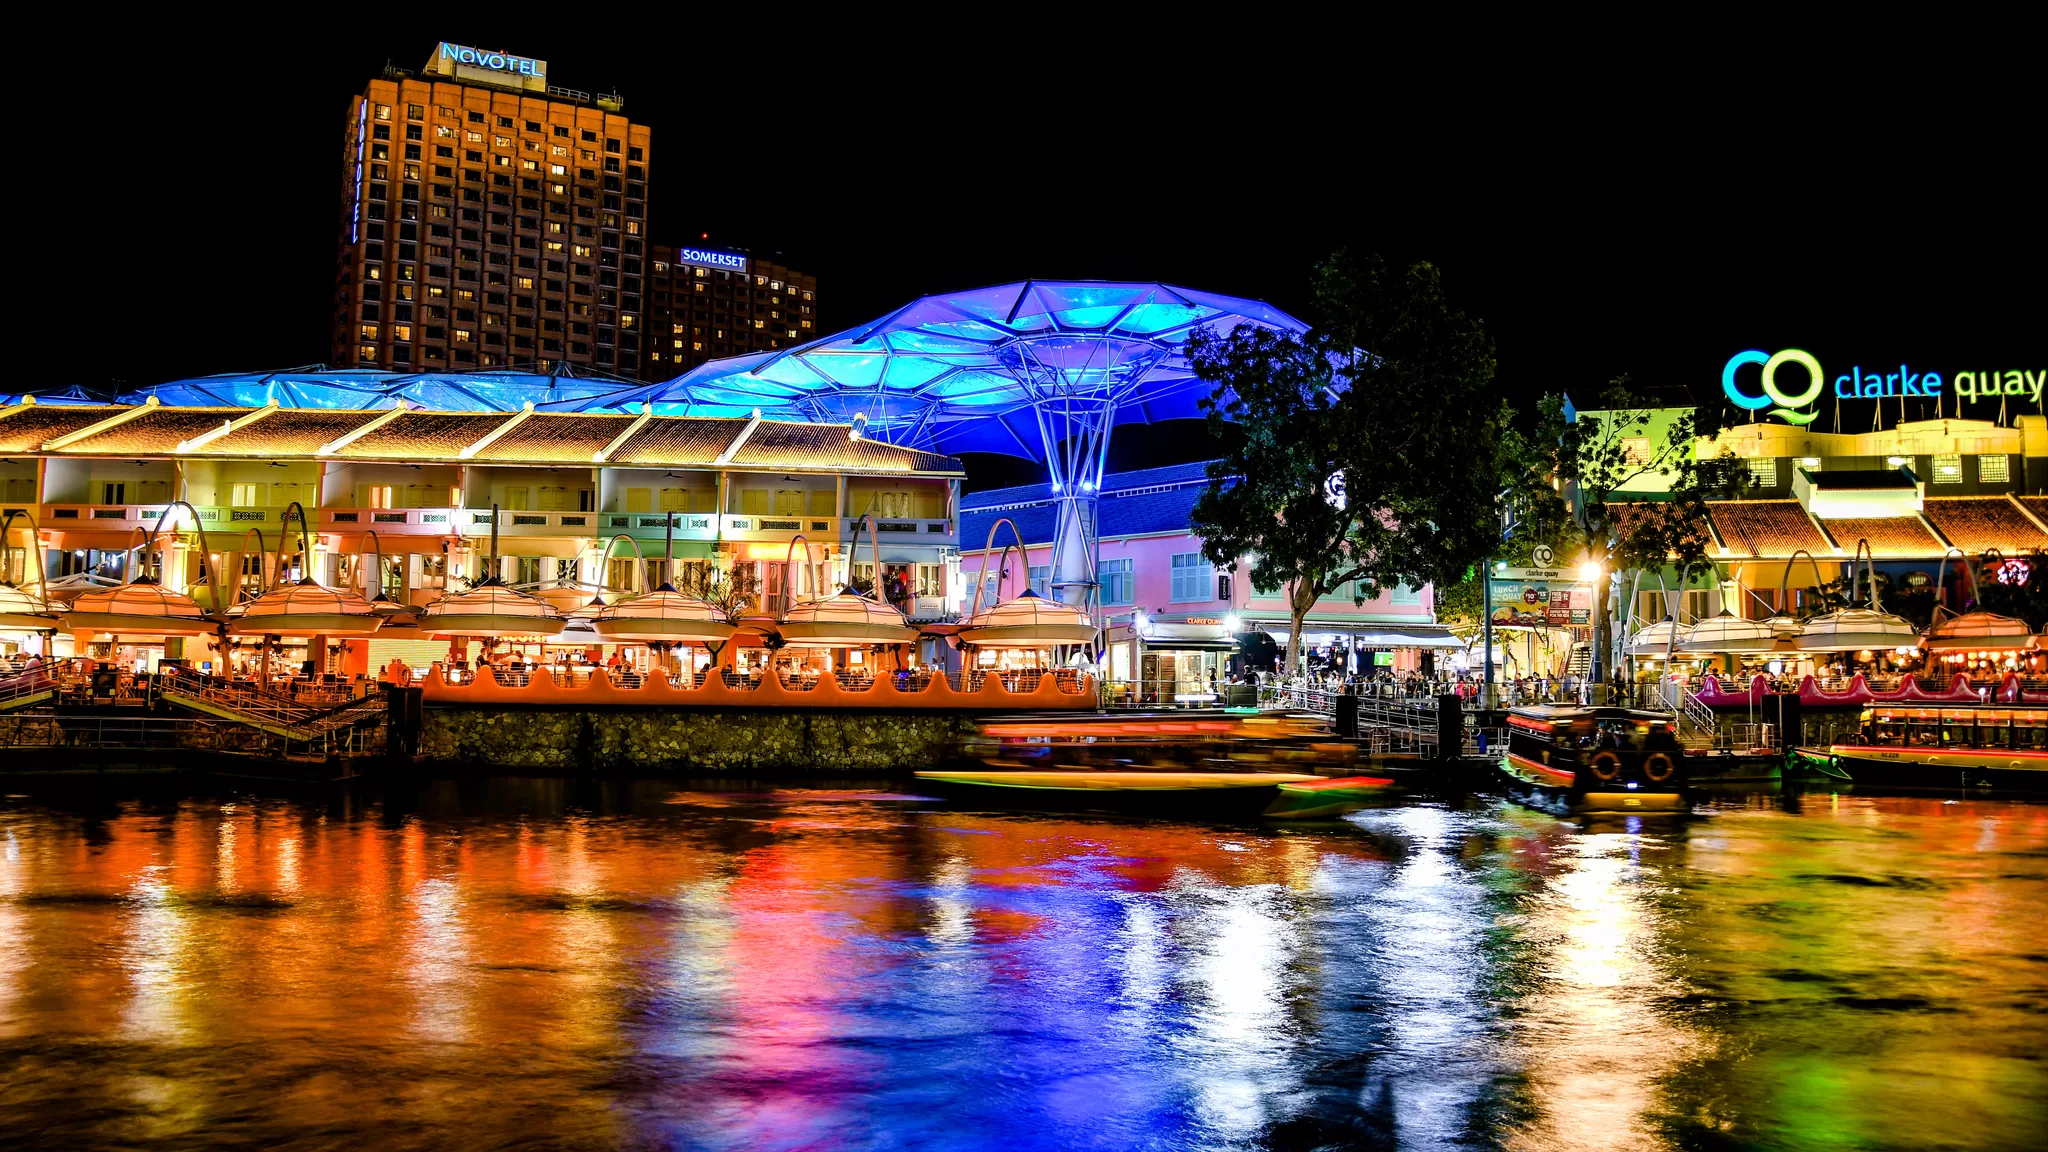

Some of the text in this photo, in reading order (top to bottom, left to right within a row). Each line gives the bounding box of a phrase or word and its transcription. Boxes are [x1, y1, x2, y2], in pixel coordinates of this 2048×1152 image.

[441, 41, 545, 78] NOVOTEL
[352, 99, 367, 244] NOVOTEL
[683, 249, 745, 268] SOMERSET
[1721, 348, 1825, 426] CQ
[1834, 364, 2047, 404] clarke quay
[1494, 585, 1519, 594] LUNCH
[1502, 592, 1522, 601] QUAY
[1187, 617, 1206, 625] CLARKE
